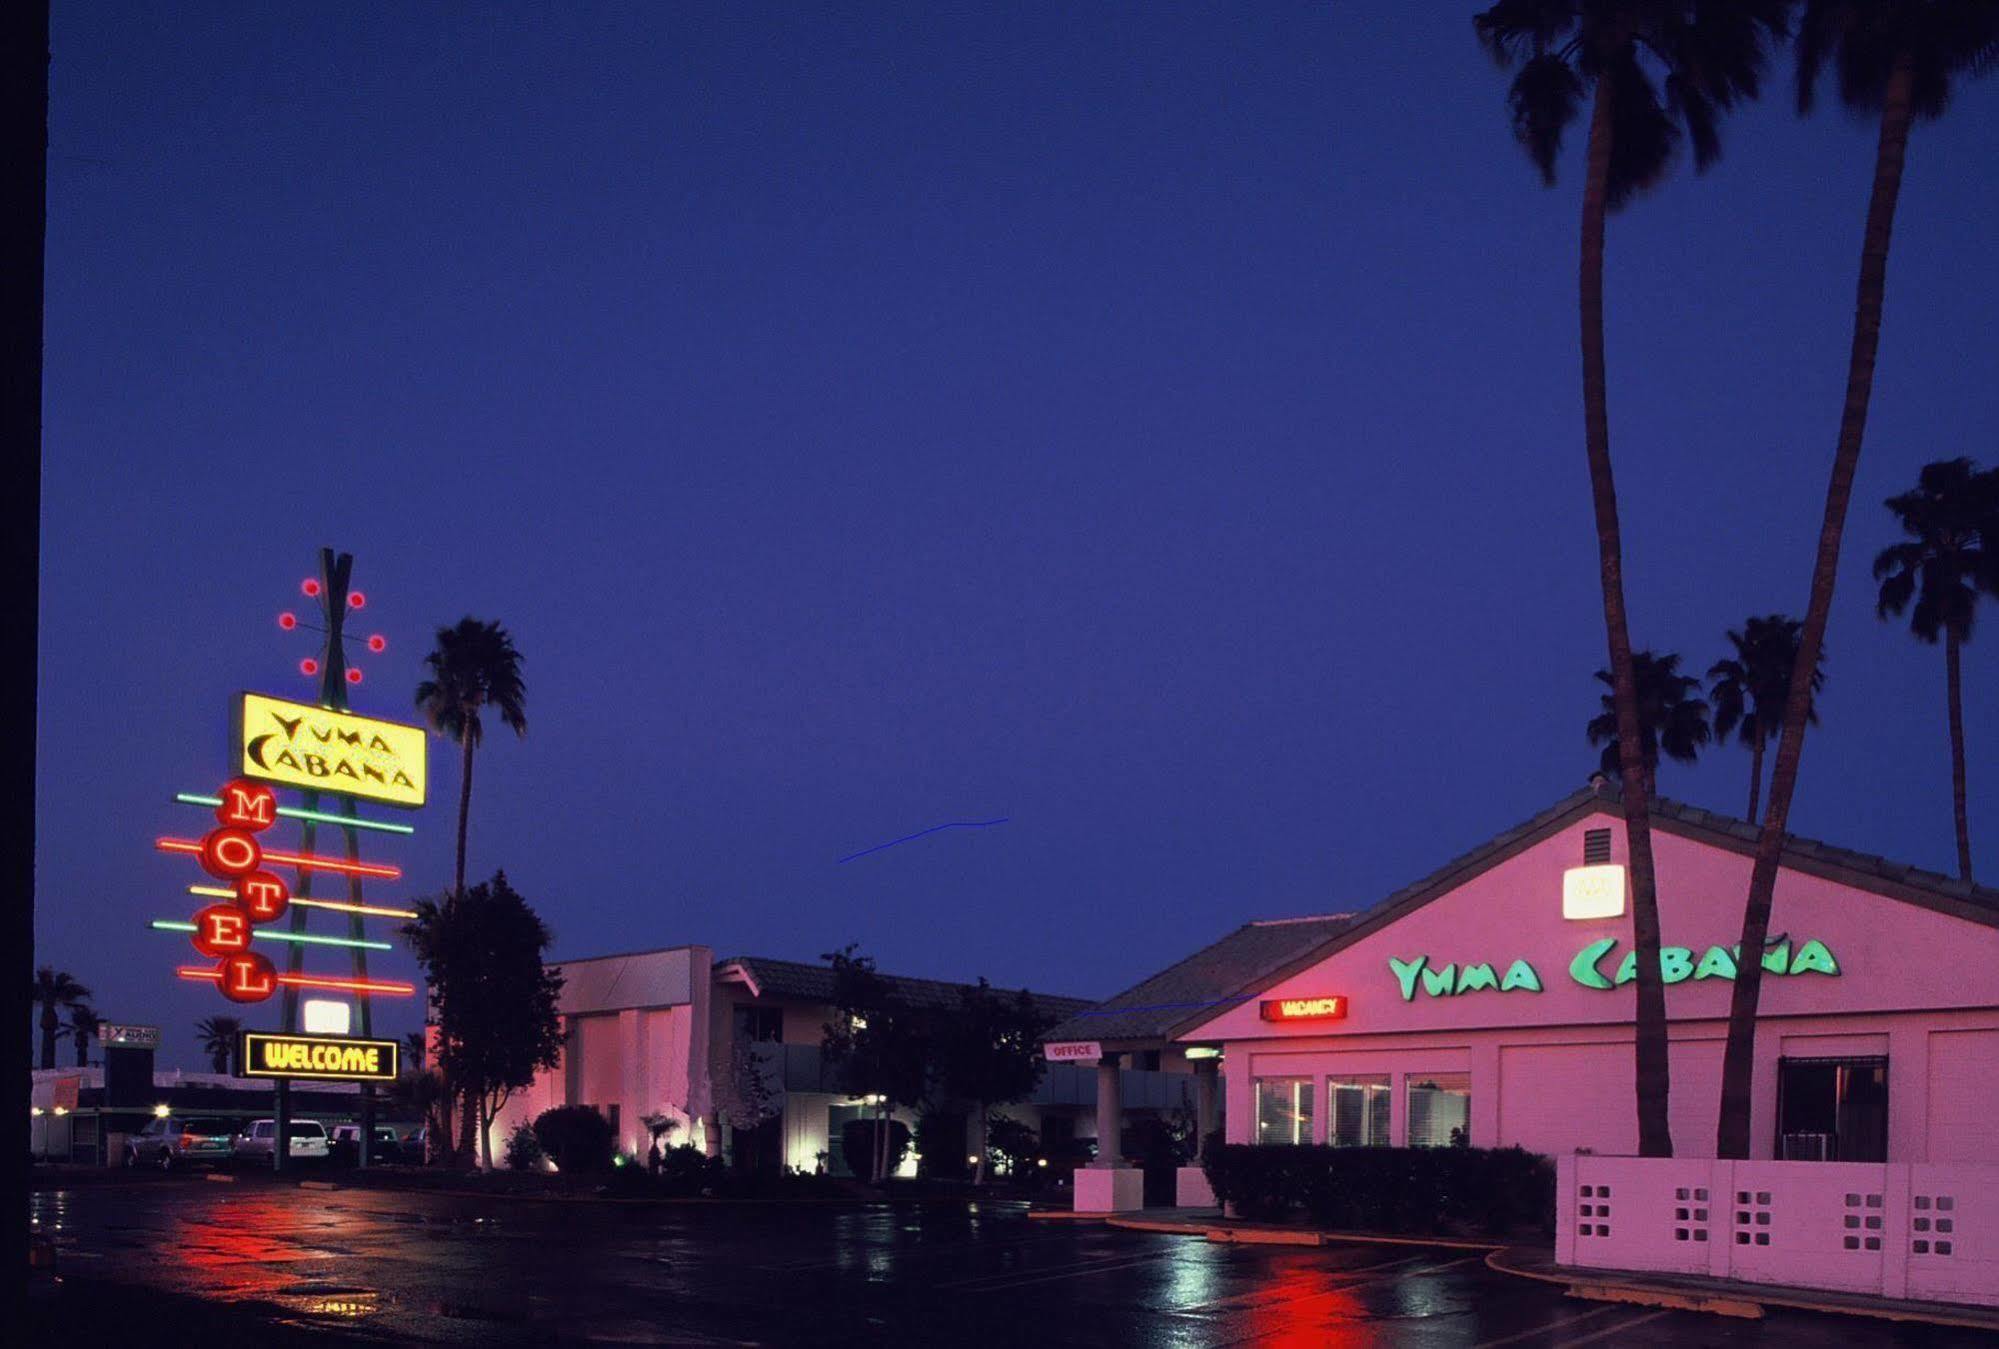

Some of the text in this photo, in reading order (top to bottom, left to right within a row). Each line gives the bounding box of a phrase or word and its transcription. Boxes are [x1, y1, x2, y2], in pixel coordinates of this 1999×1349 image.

[271, 711, 393, 754] YUMA
[247, 733, 417, 790] CABANA
[209, 789, 281, 992] MOTEL
[1281, 998, 1337, 1016] VACANCY
[264, 1041, 379, 1073] WELCOME
[1054, 1044, 1093, 1057] OFFICE
